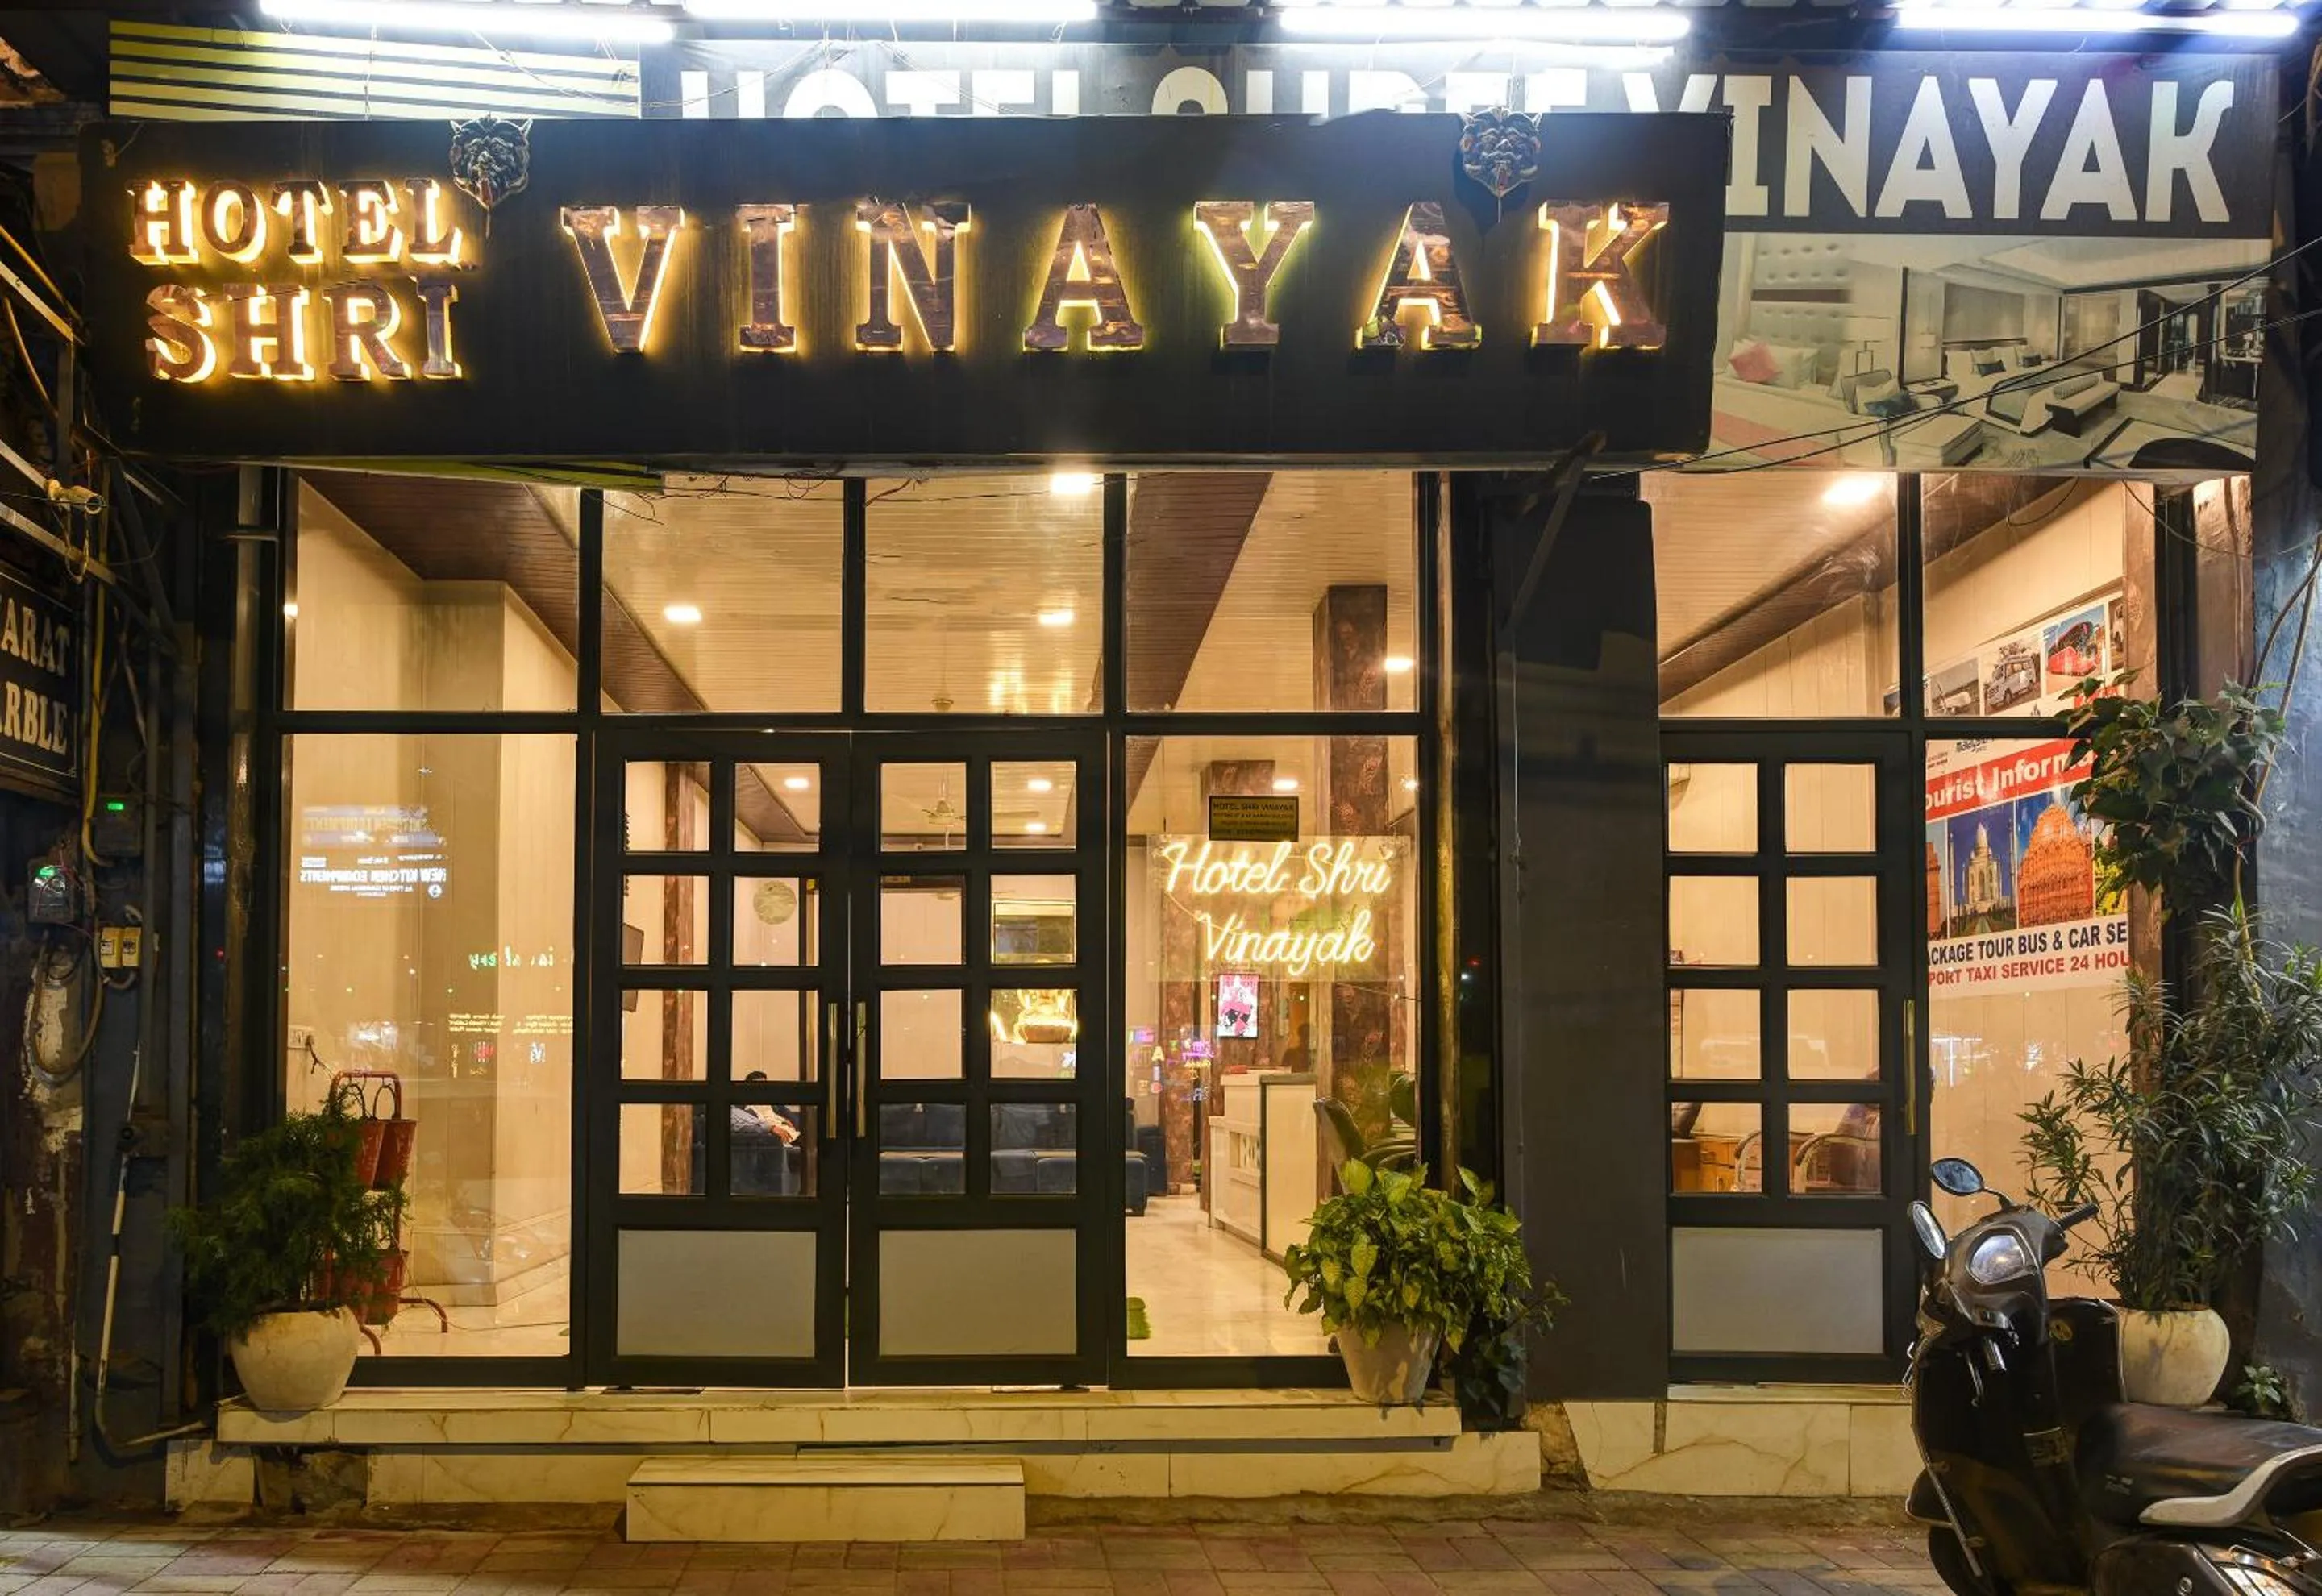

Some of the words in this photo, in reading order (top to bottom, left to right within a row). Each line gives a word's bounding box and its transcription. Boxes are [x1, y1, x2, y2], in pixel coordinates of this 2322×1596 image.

[127, 177, 463, 266] HOTEL
[560, 198, 1671, 356] VINAYAK
[146, 274, 463, 384] SHRI
[0, 596, 70, 677] ARAT
[0, 680, 68, 756] RBLE
[1161, 840, 1290, 895] Hotel
[1298, 840, 1394, 898] Shri
[1197, 909, 1375, 976] Vinayak
[1928, 968, 1962, 987] PORT
[1966, 966, 1997, 982] TAXI
[2001, 957, 2066, 979] SERVICE
[2070, 954, 2090, 971] 24
[2095, 950, 2133, 970] HOU
[1977, 939, 2015, 960] TOUR
[2018, 930, 2048, 954] BUS
[2052, 929, 2063, 950] &
[2069, 925, 2101, 949] CAR
[2106, 921, 2128, 945] SE
